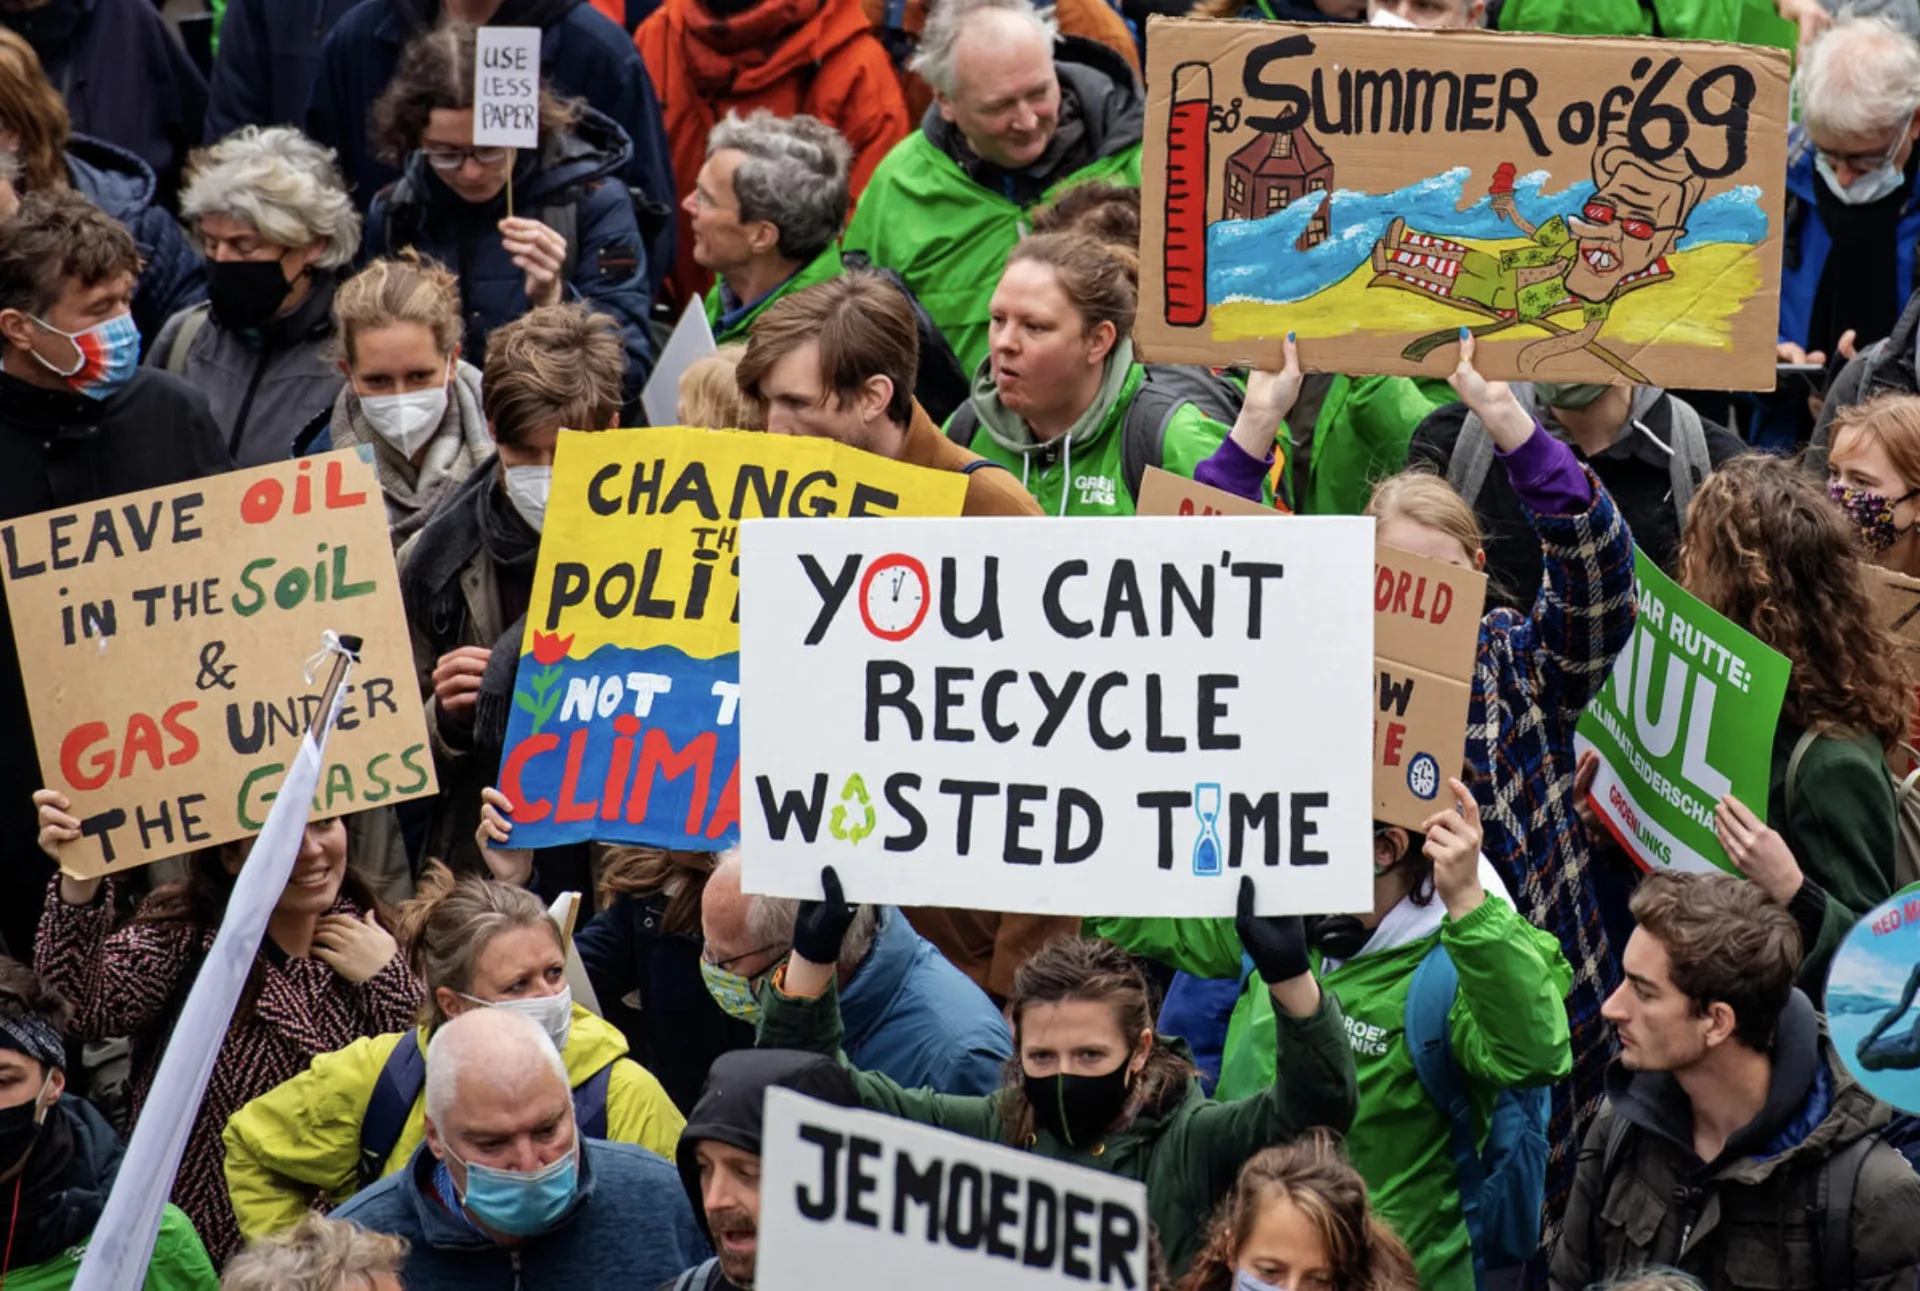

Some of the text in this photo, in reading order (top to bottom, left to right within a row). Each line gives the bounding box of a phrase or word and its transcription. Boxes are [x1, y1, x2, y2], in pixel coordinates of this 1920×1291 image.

[483, 46, 528, 70] USE
[483, 76, 532, 98] LESS
[482, 102, 536, 130] PAPER
[1, 493, 204, 580] LEAVE
[132, 577, 224, 627] THE
[797, 550, 1284, 645] YOU CAN'T
[1374, 564, 1453, 625] ORLD
[1636, 578, 1752, 694] AR RUTTE:
[196, 640, 238, 690] &
[559, 672, 673, 722] NOT
[864, 659, 1242, 753] RECYCLE
[60, 700, 199, 791] GAS
[1587, 698, 1719, 836] KLIMAATLEIDERSCHA
[81, 743, 429, 864] THE GASS
[1608, 784, 1673, 866] GROENLINKS
[892, 1150, 1141, 1291] MOEDER
